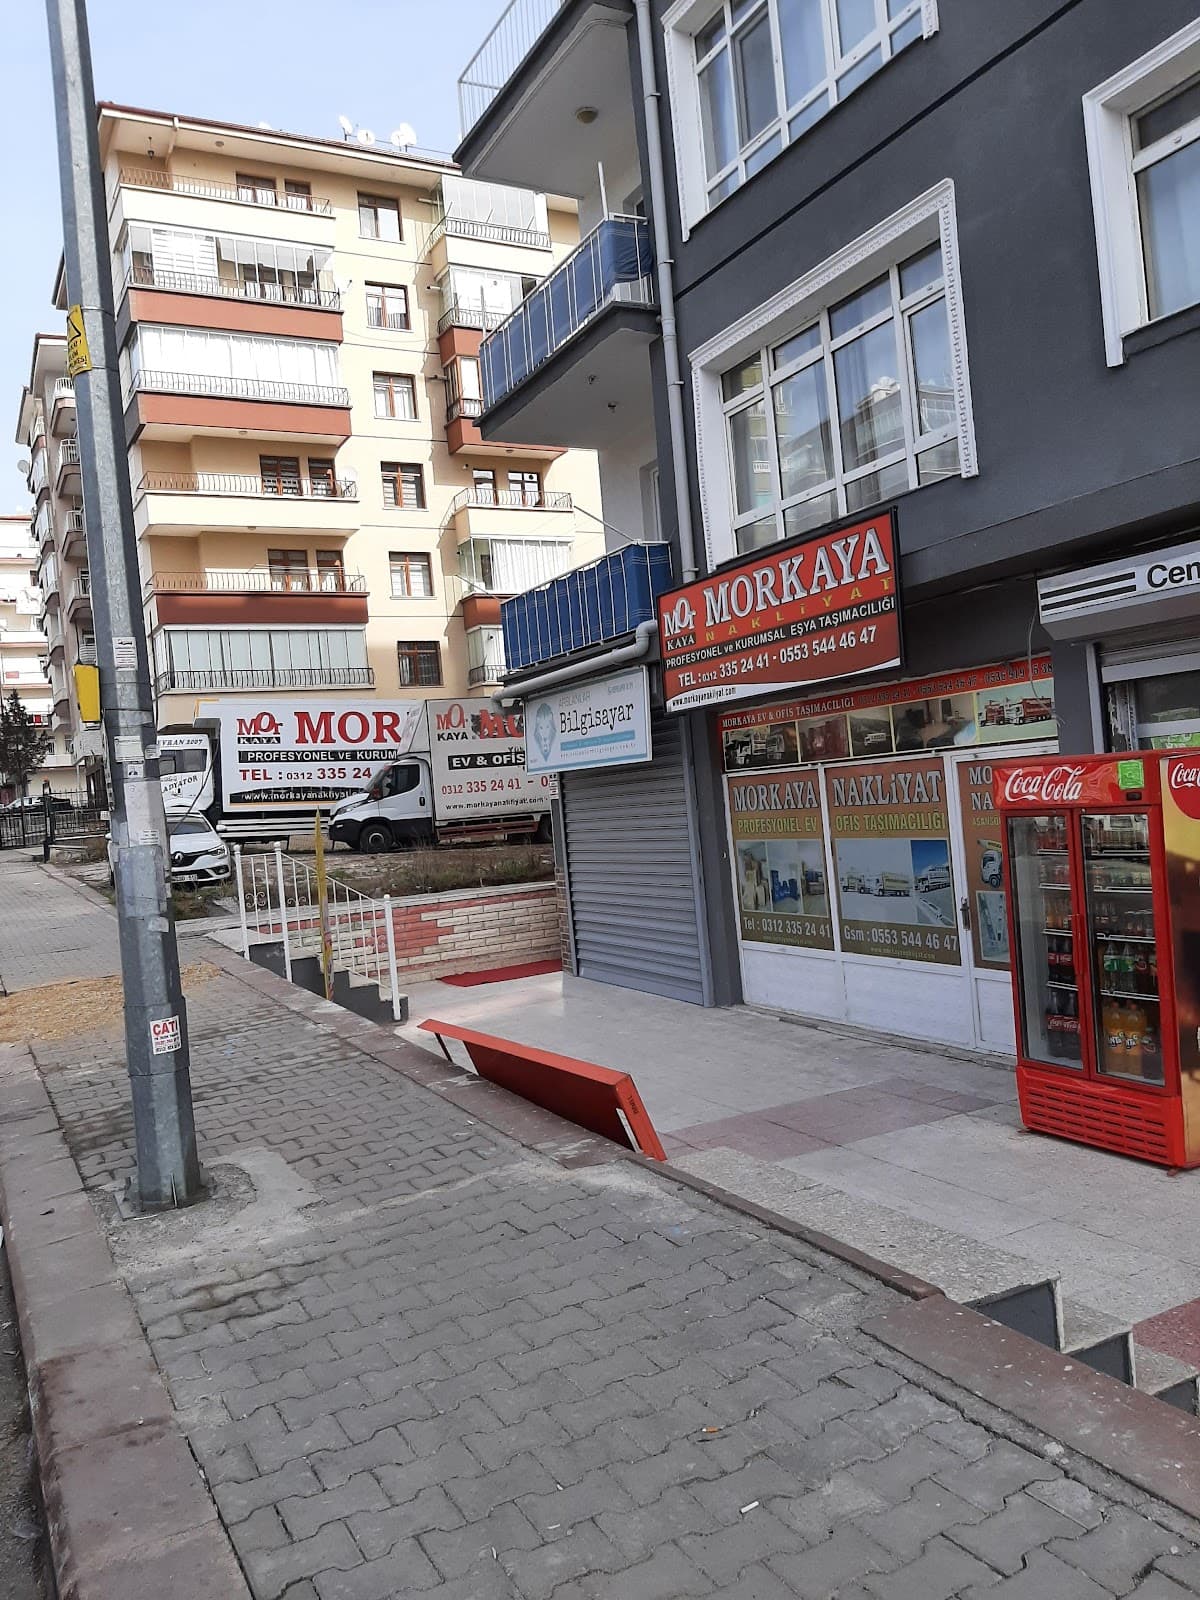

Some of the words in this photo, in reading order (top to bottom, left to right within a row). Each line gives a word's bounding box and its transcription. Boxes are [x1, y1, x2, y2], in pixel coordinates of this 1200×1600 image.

[703, 527, 890, 627] MORKAYA
[666, 646, 722, 669] PROFESYONEL
[724, 645, 733, 653] ve
[735, 628, 786, 650] KURUMSAL
[790, 620, 816, 637] EŞYA
[667, 635, 695, 650] KAYA
[679, 671, 696, 687] TEL
[702, 671, 718, 682] 0312
[719, 661, 738, 678] 335
[741, 658, 754, 673] 24
[756, 652, 769, 669] 41
[780, 643, 808, 663] 0553
[812, 635, 836, 656] 544
[839, 632, 856, 648] 46
[860, 625, 877, 644] 47
[560, 703, 634, 735] Bilgisayar
[437, 731, 469, 741] KAYA
[247, 751, 334, 761] PROFESYONEL
[338, 751, 352, 760] VE
[356, 750, 397, 760] KURUM
[452, 757, 471, 768] EV
[476, 755, 487, 766] &
[239, 769, 272, 780] TEL
[286, 772, 313, 780] 0312
[317, 768, 346, 779] 335
[353, 768, 372, 779] 24
[1005, 766, 1087, 802] Coca-Cola
[441, 784, 463, 795] 0312
[466, 781, 487, 793] 335
[490, 779, 504, 791] 24
[508, 778, 521, 790] 41
[732, 780, 818, 812] MORKAYA
[737, 817, 802, 833] PROFESYONEL
[805, 816, 816, 832] EV
[744, 917, 755, 930] Tel
[762, 918, 783, 933] 0312
[786, 920, 802, 935] 335
[805, 922, 816, 937] 24
[820, 923, 830, 938] 41
[844, 925, 864, 941] Gsm
[871, 927, 898, 945] 0553
[901, 930, 922, 947] 544
[925, 933, 939, 949] 46
[943, 935, 957, 951] 47
